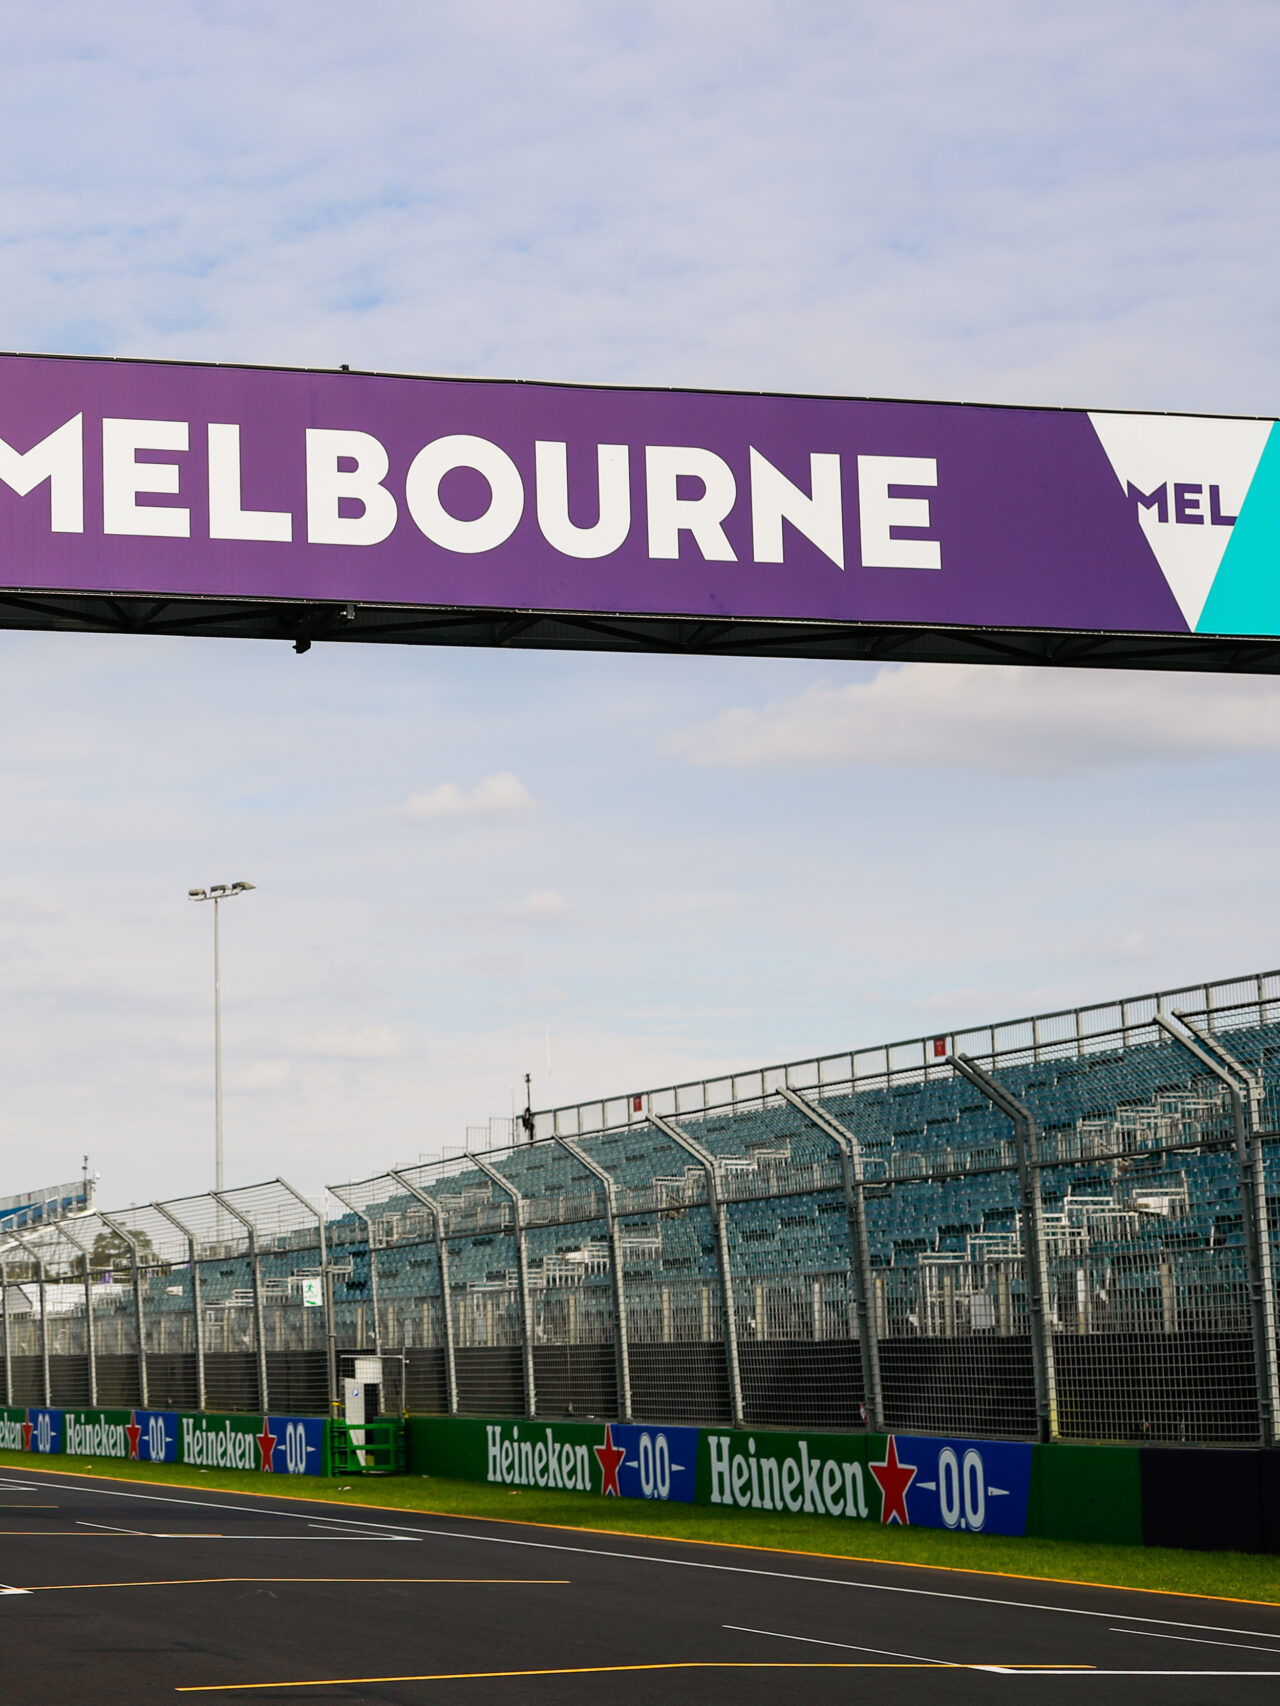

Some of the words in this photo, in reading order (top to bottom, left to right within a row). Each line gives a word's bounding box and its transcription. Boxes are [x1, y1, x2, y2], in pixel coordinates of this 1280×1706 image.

[1126, 480, 1238, 527] MEL
[65, 1414, 125, 1457] Heineken
[182, 1418, 255, 1469] Heineken
[486, 1425, 591, 1491] Heineken
[639, 1432, 670, 1499] 0.0
[708, 1436, 868, 1518] Heineken
[938, 1447, 985, 1531] 0.0
